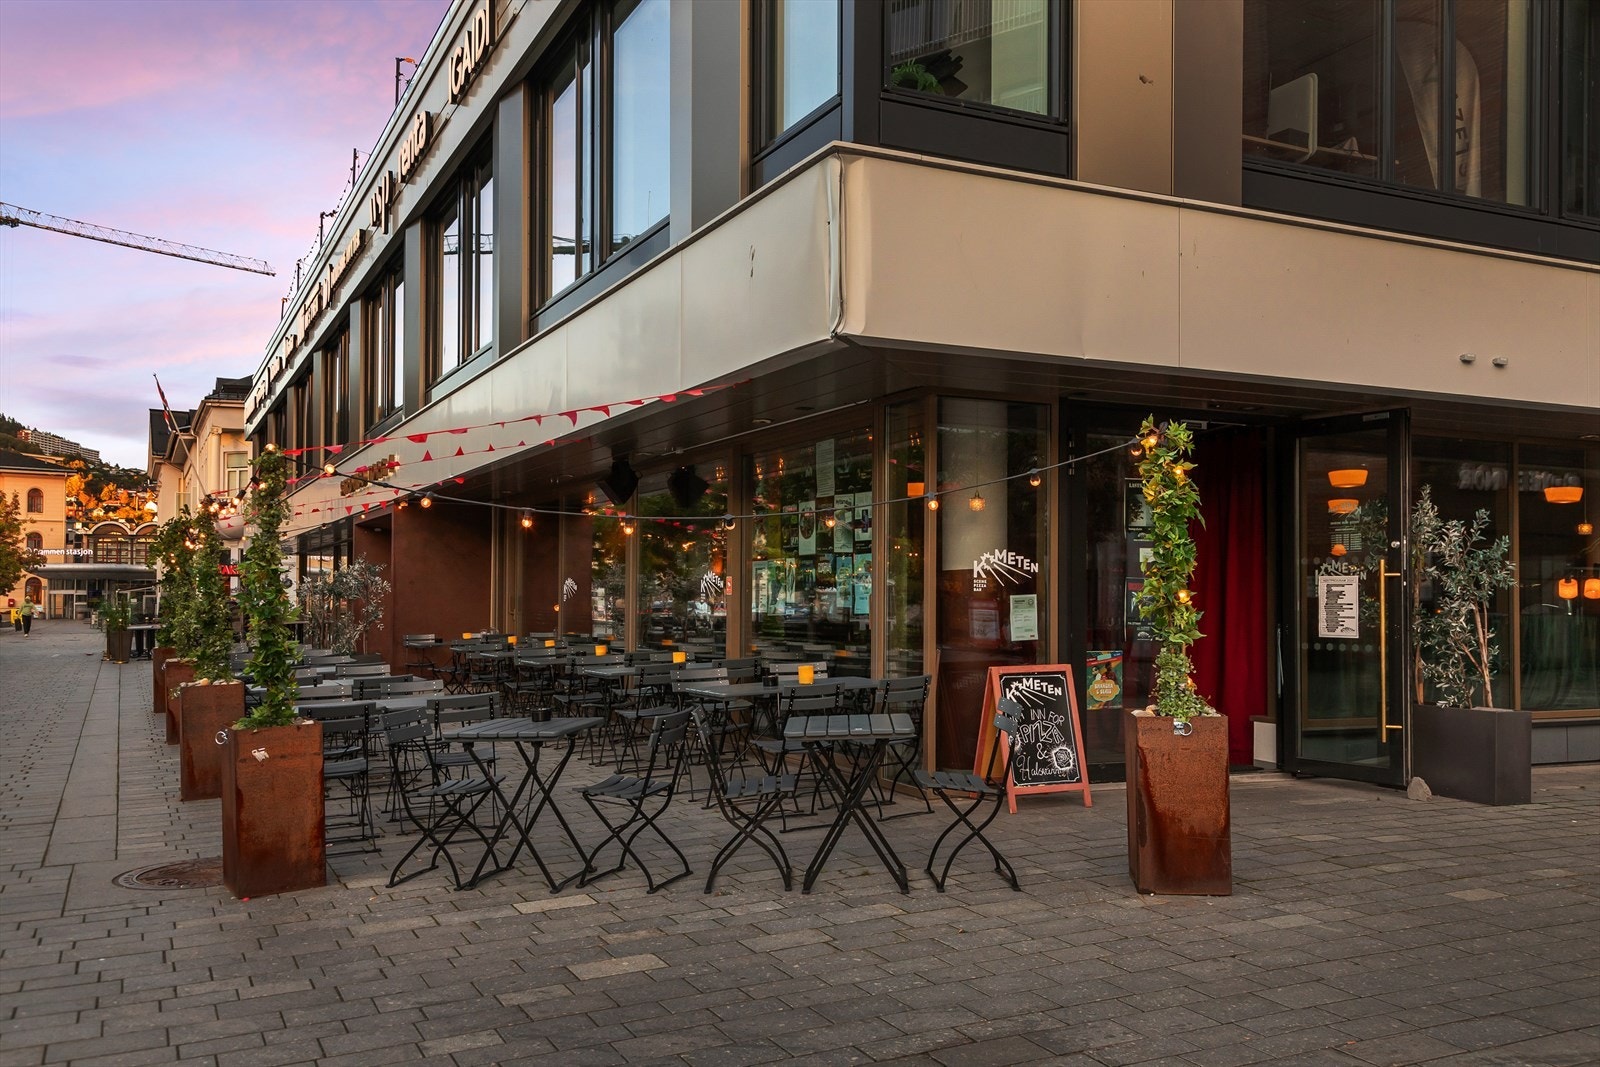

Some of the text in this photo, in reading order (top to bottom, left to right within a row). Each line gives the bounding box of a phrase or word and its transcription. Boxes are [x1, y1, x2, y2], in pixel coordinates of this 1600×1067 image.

[66, 548, 93, 557] stasjon
[1047, 711, 1065, 727] FOR
[1020, 719, 1065, 744] PIZZA
